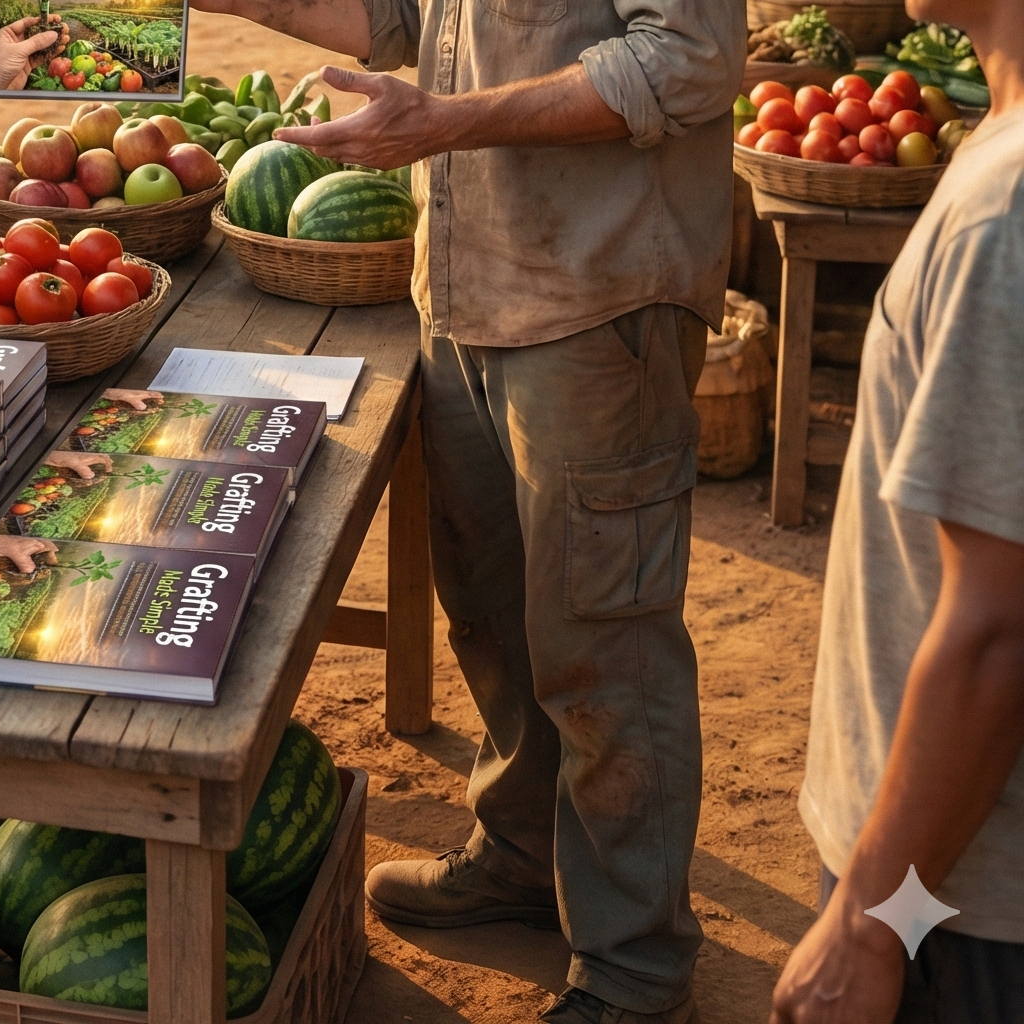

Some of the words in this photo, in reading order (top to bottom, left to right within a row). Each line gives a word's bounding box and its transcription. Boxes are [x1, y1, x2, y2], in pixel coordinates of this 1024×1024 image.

[246, 405, 302, 453] Grafting
[201, 472, 264, 534] Grafting
[155, 563, 229, 648] Grafting
